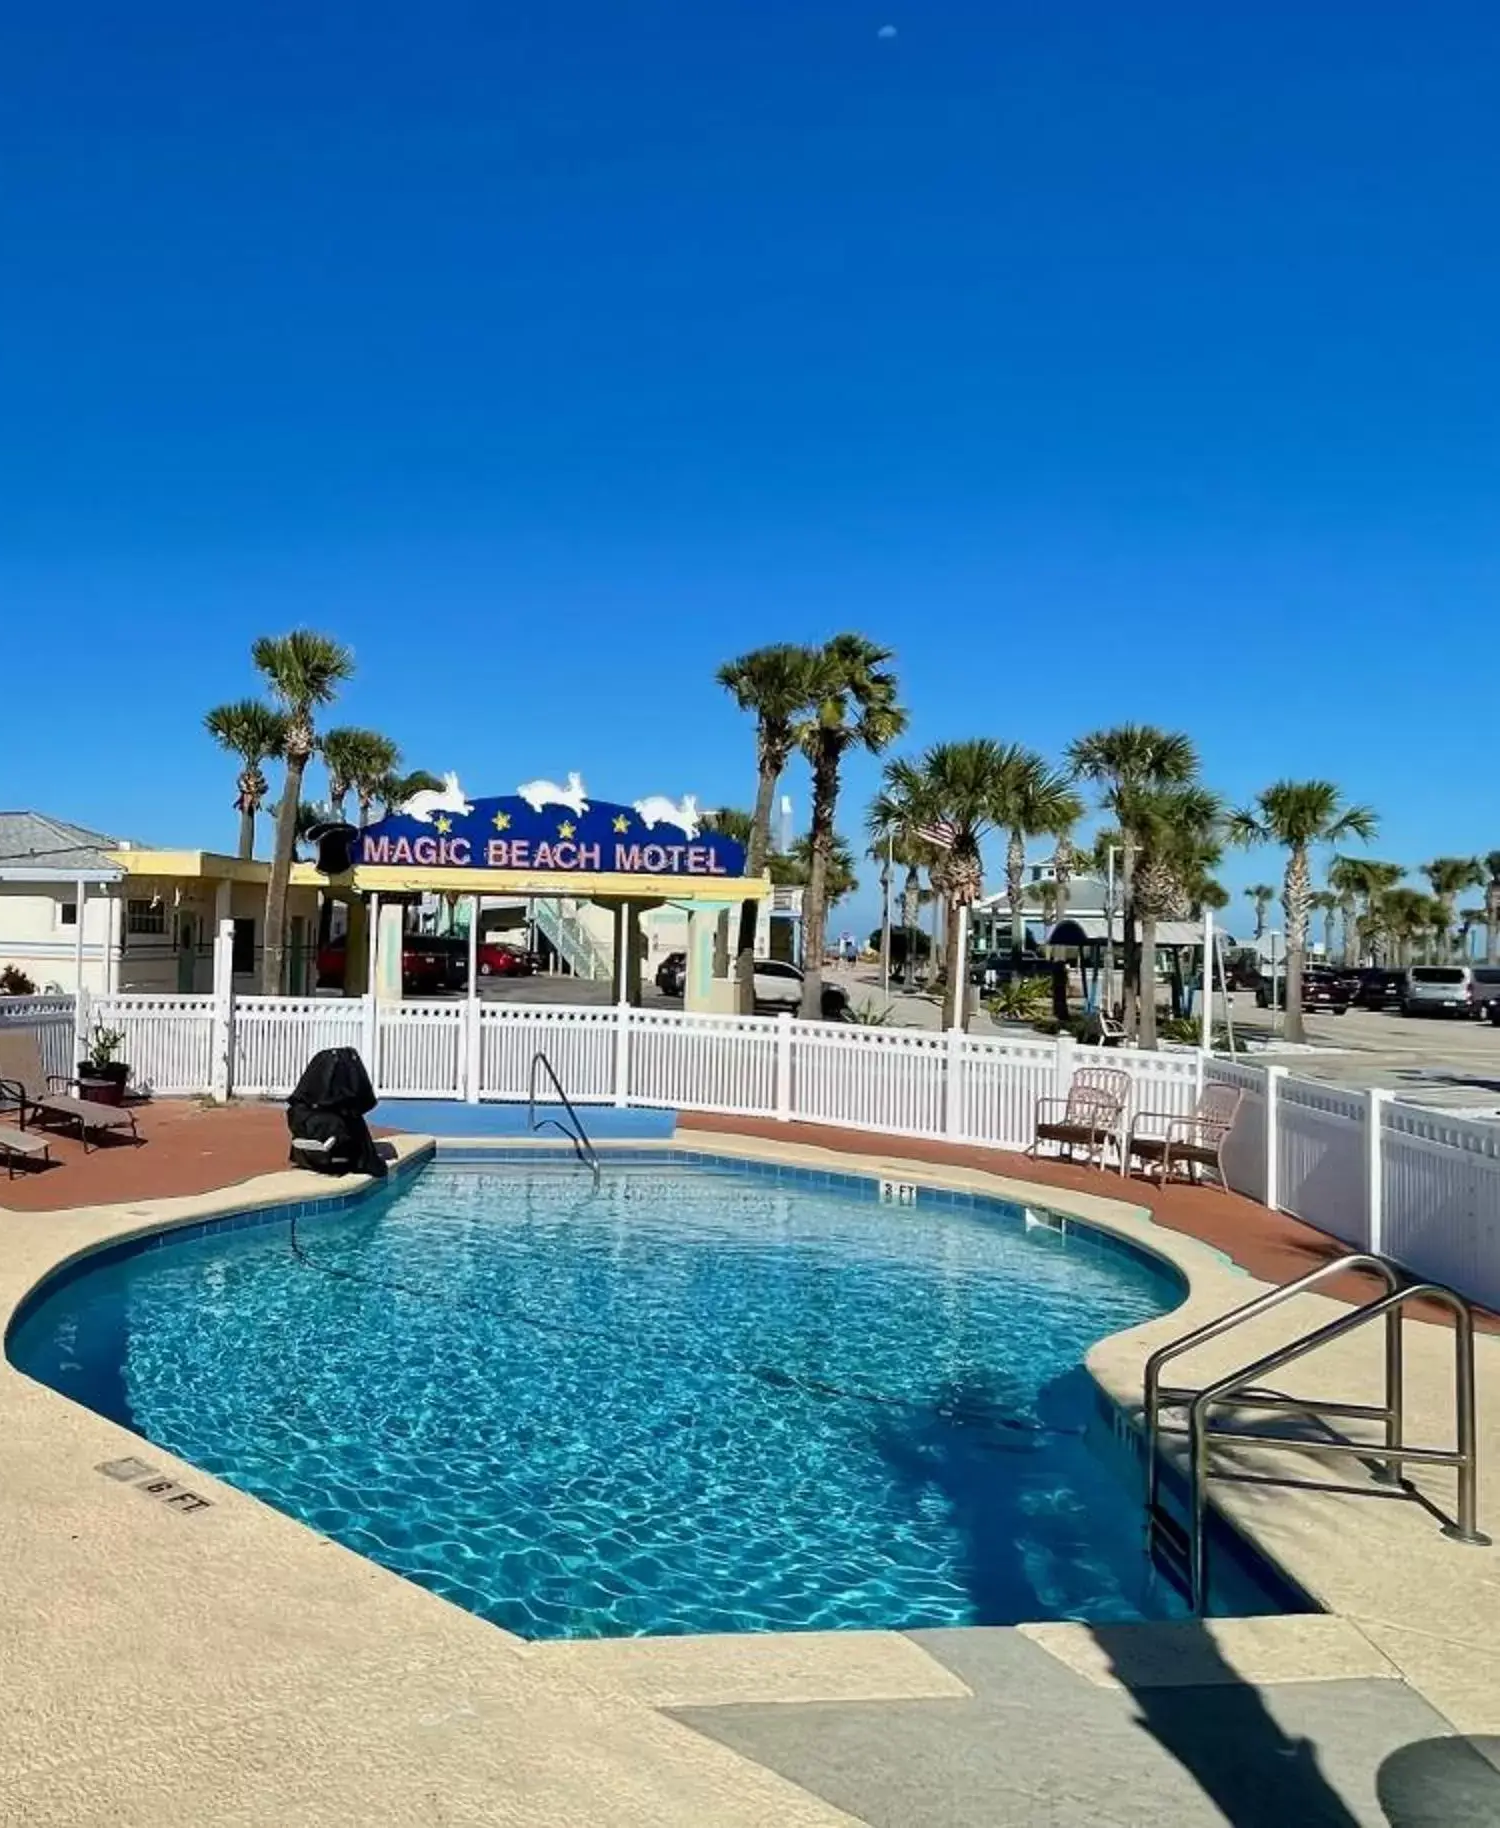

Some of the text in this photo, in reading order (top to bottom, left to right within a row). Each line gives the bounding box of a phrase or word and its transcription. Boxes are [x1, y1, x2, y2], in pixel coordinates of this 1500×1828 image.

[363, 835, 726, 873] MAGIC BEACH MOTEL
[147, 1482, 210, 1510] 6 FT
